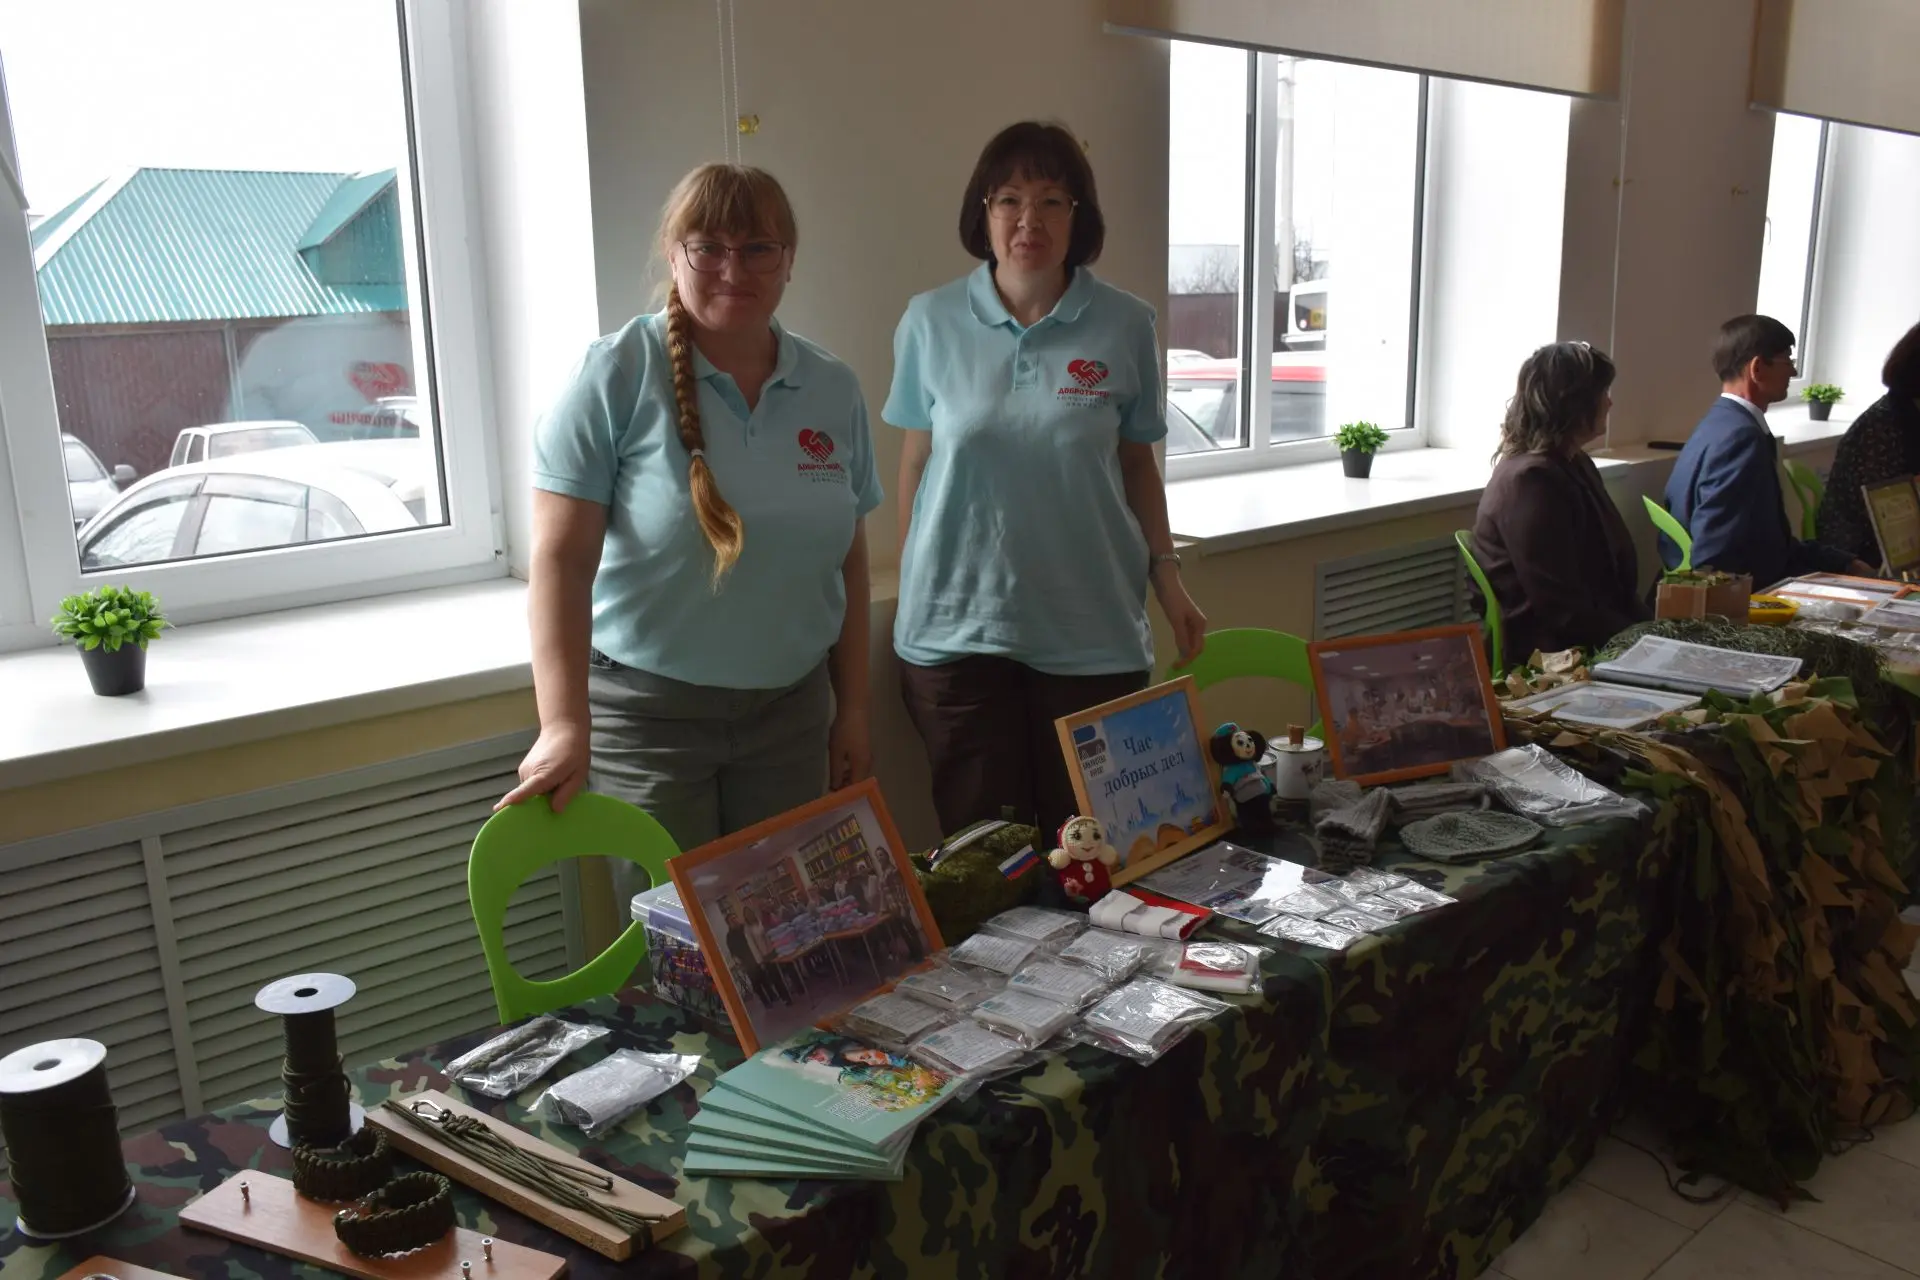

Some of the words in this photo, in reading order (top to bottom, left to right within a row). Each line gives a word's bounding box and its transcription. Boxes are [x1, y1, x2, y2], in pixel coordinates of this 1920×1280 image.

[1123, 735, 1152, 755] Час
[1104, 761, 1158, 797] добрых
[1160, 751, 1185, 772] дел
